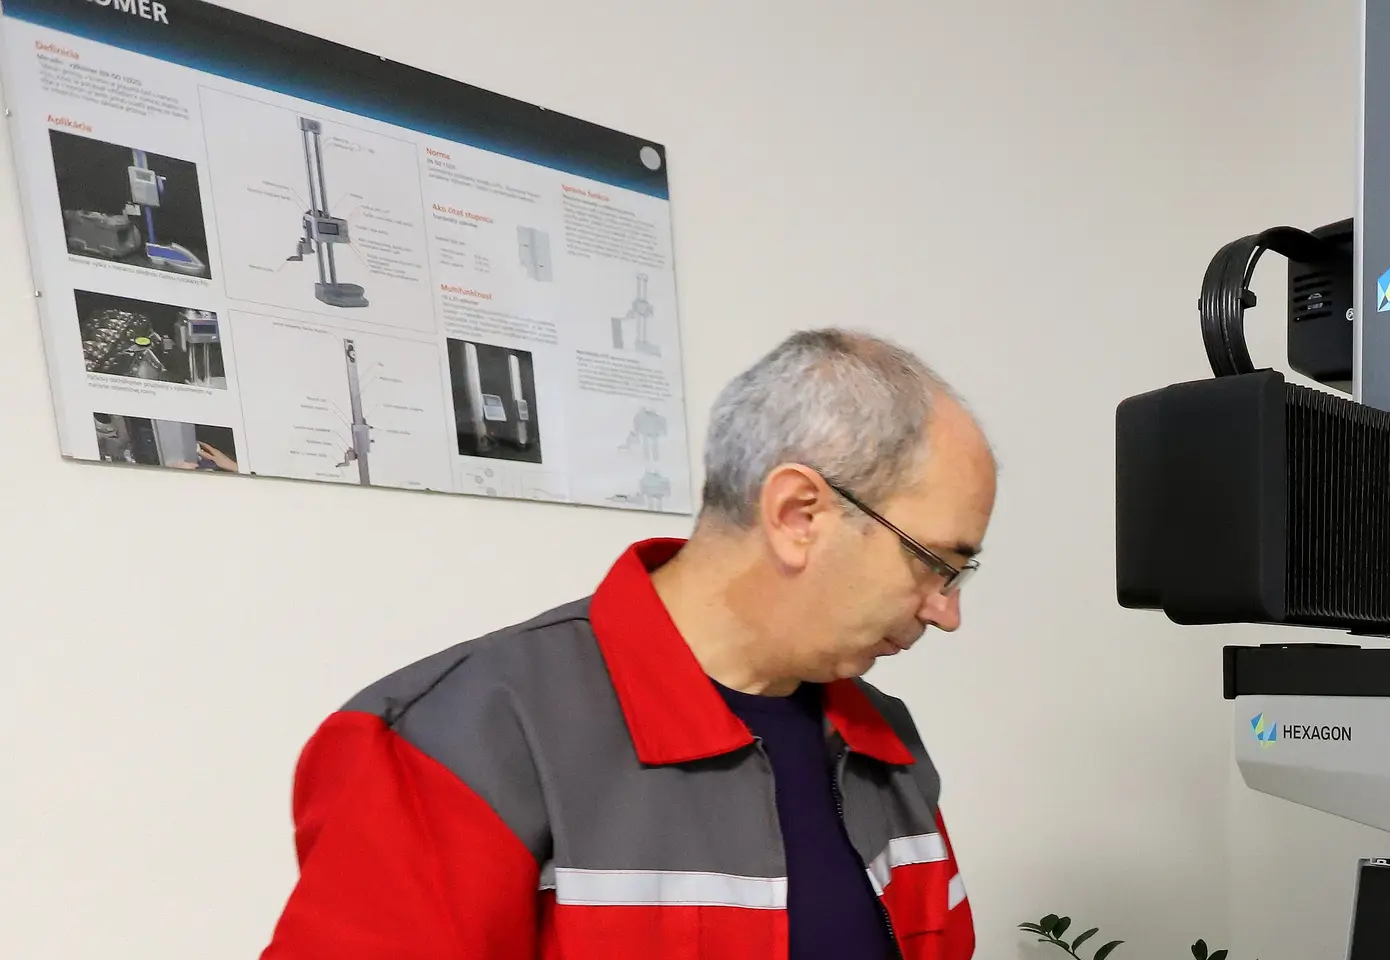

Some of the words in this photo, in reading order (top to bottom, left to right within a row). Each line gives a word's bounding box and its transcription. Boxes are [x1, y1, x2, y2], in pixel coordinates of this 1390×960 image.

[86, 0, 169, 25] MER
[426, 147, 451, 160] Norma
[1283, 725, 1352, 741] HEXAGON
